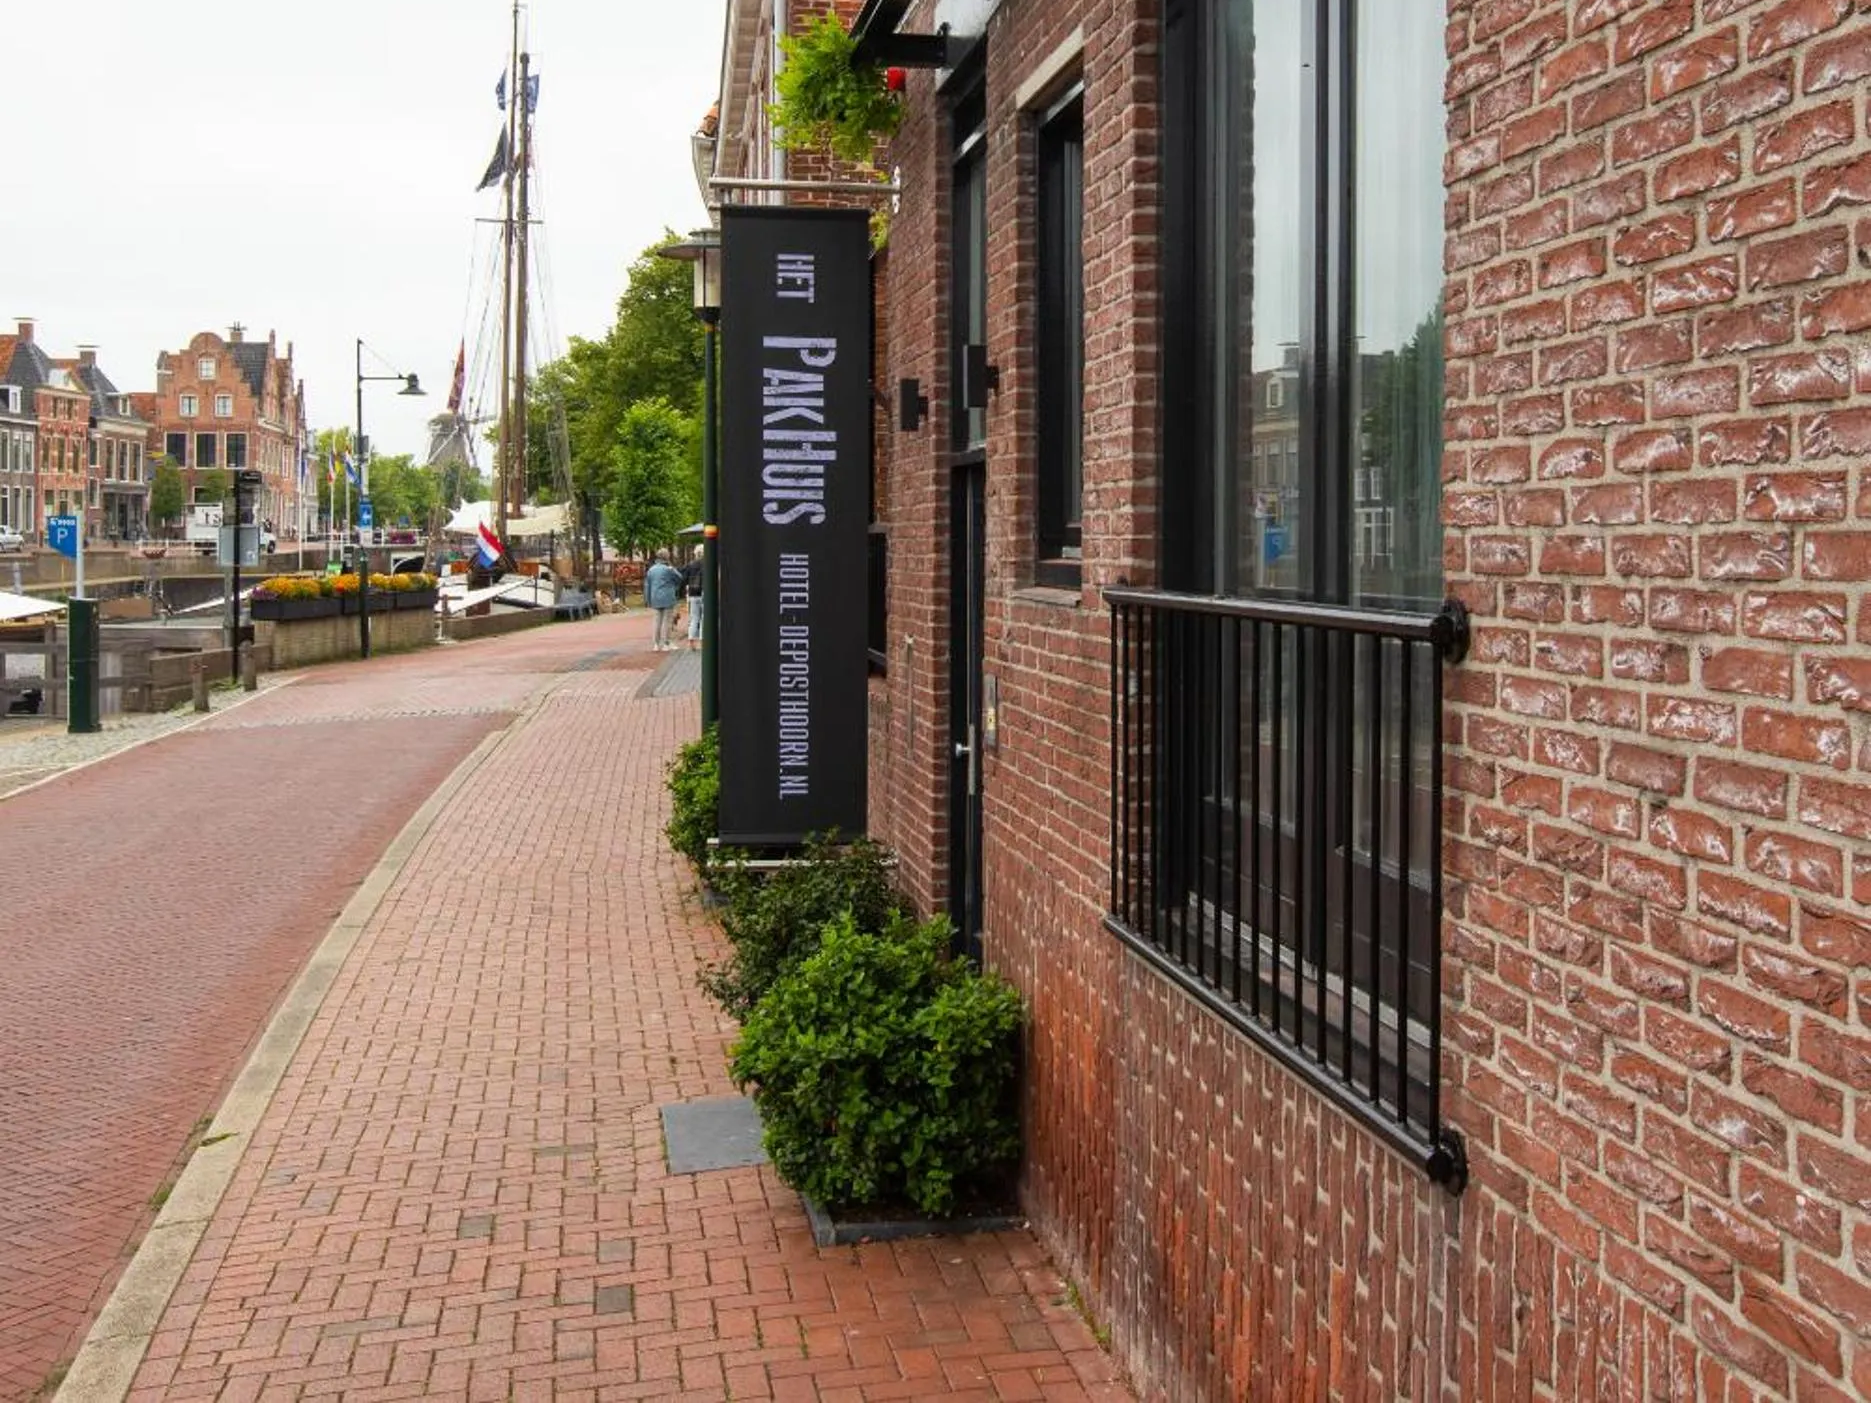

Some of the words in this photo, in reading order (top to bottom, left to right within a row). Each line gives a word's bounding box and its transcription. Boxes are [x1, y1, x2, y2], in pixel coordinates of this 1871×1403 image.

[776, 253, 814, 303] HET
[762, 335, 836, 524] PAKHUIS
[57, 527, 69, 545] P
